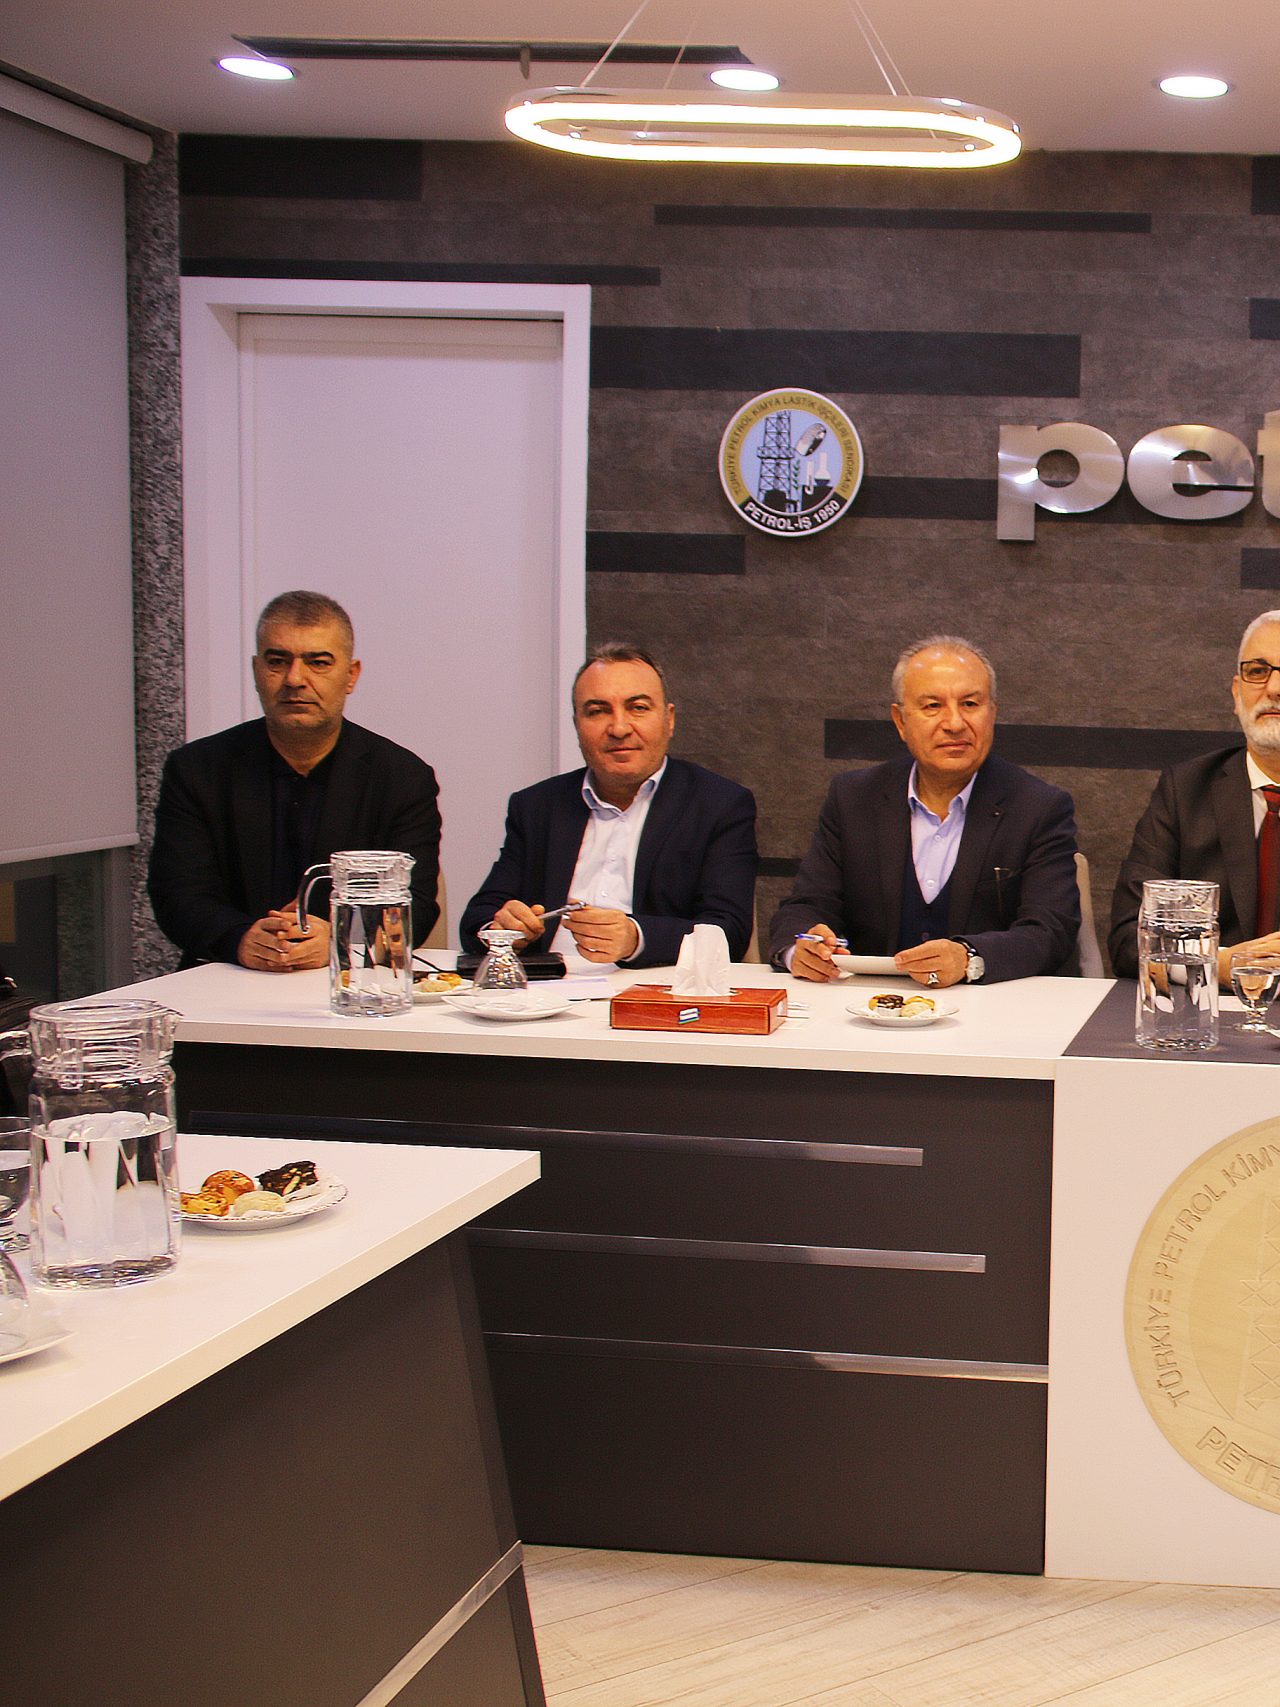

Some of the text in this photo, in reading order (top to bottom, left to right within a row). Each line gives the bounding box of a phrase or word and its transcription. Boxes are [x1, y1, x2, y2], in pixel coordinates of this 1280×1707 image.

[730, 414, 752, 449] PETROL
[813, 500, 840, 523] 1950
[1154, 1177, 1227, 1282] PETROL
[1143, 1287, 1190, 1408] TÜRKİYE
